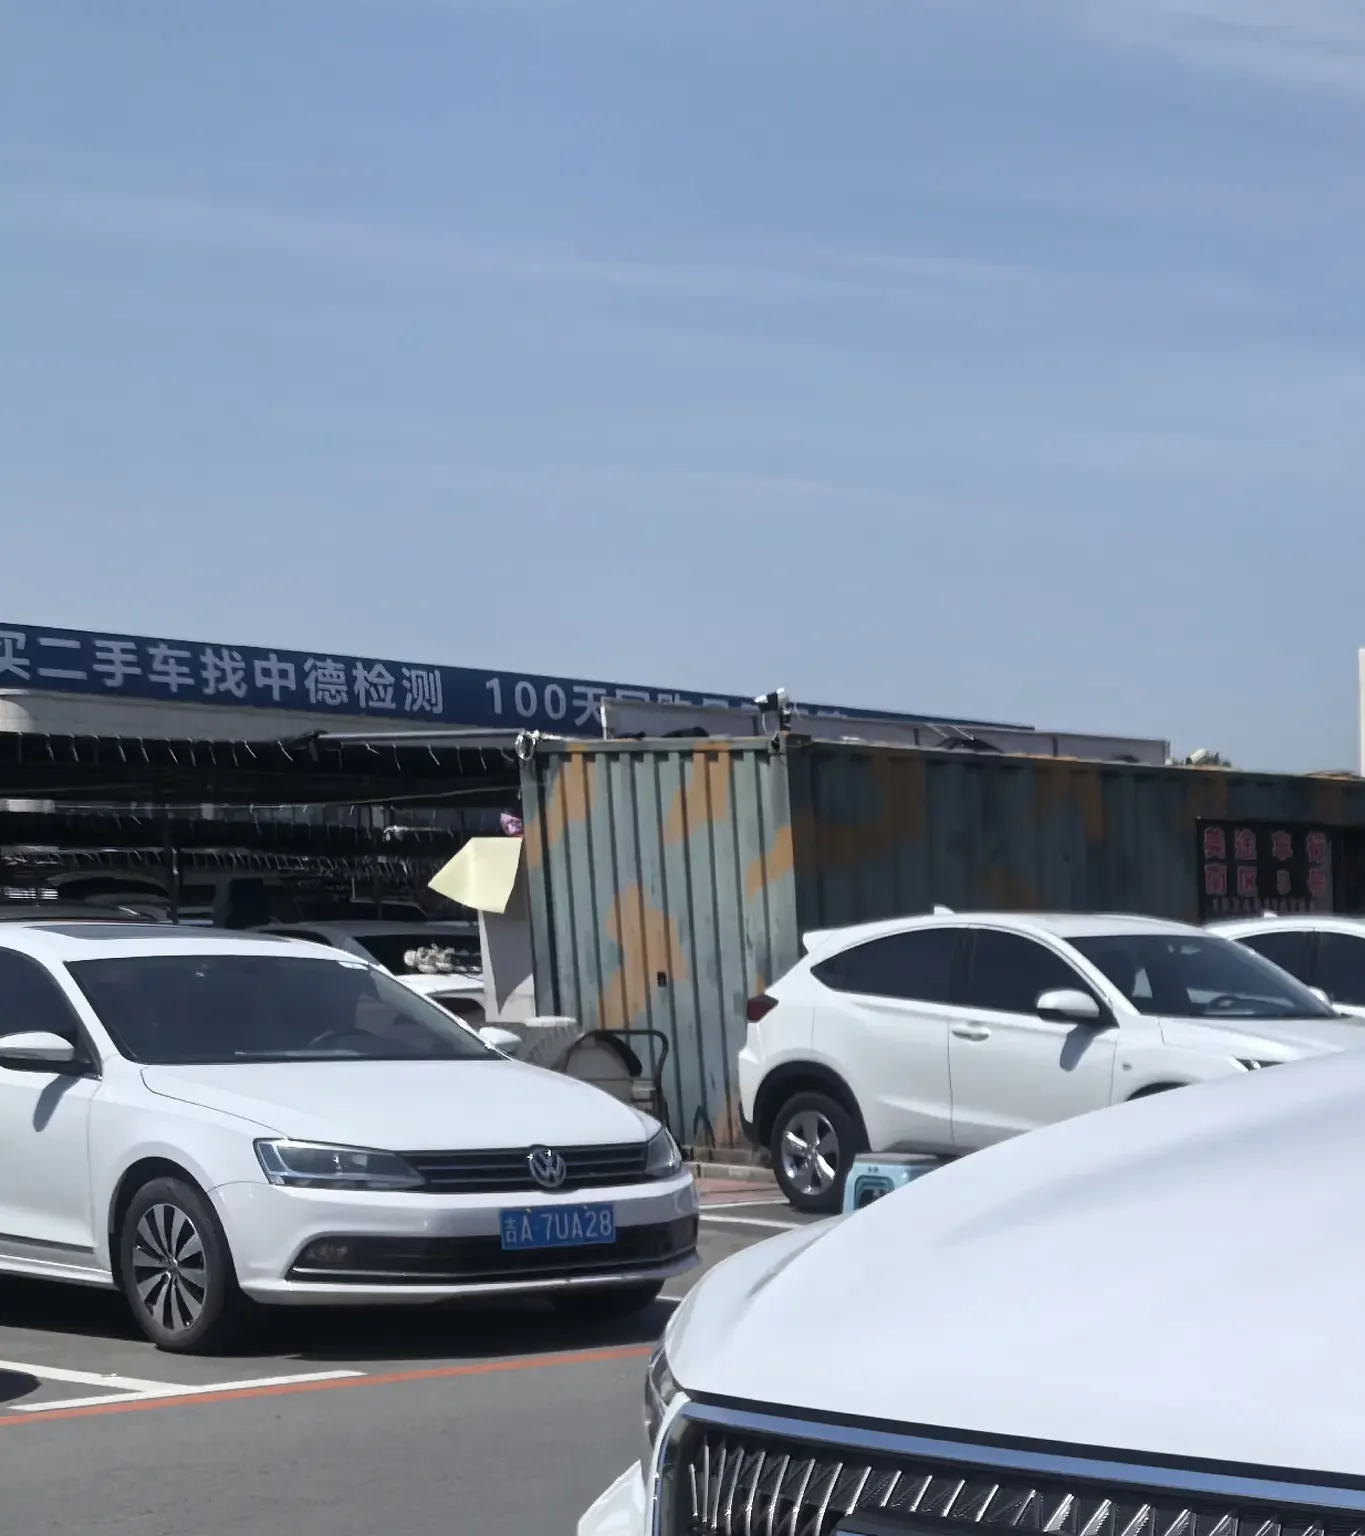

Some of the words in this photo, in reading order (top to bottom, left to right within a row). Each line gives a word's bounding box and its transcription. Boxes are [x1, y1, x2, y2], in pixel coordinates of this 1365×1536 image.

[0, 630, 443, 714] 买二手车找中德检测
